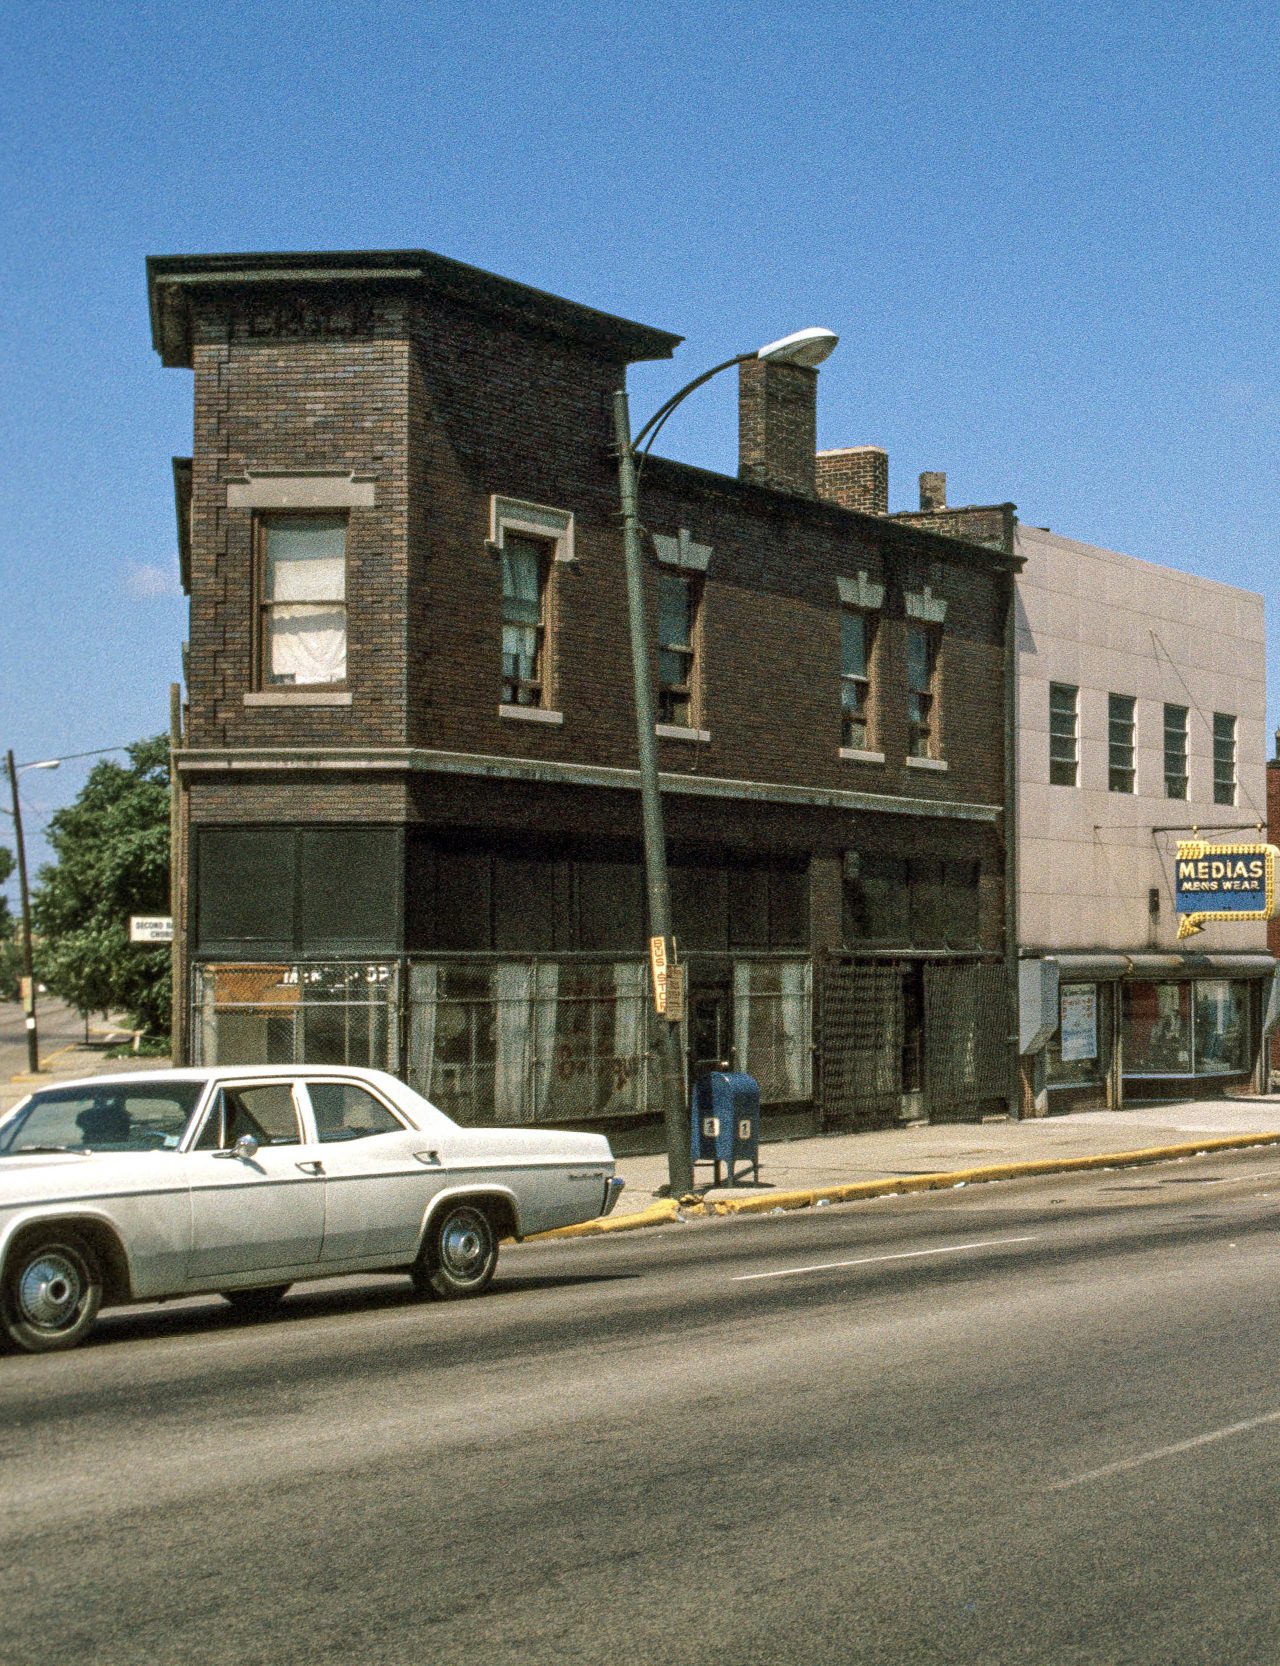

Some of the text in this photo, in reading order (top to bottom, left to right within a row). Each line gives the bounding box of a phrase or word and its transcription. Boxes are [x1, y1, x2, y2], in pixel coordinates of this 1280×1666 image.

[1179, 860, 1264, 878] MEDIAS
[1181, 880, 1260, 891] MENS WEAR
[136, 921, 163, 930] SECOND
[653, 938, 665, 967] BUS
[656, 971, 668, 1011] STOP
